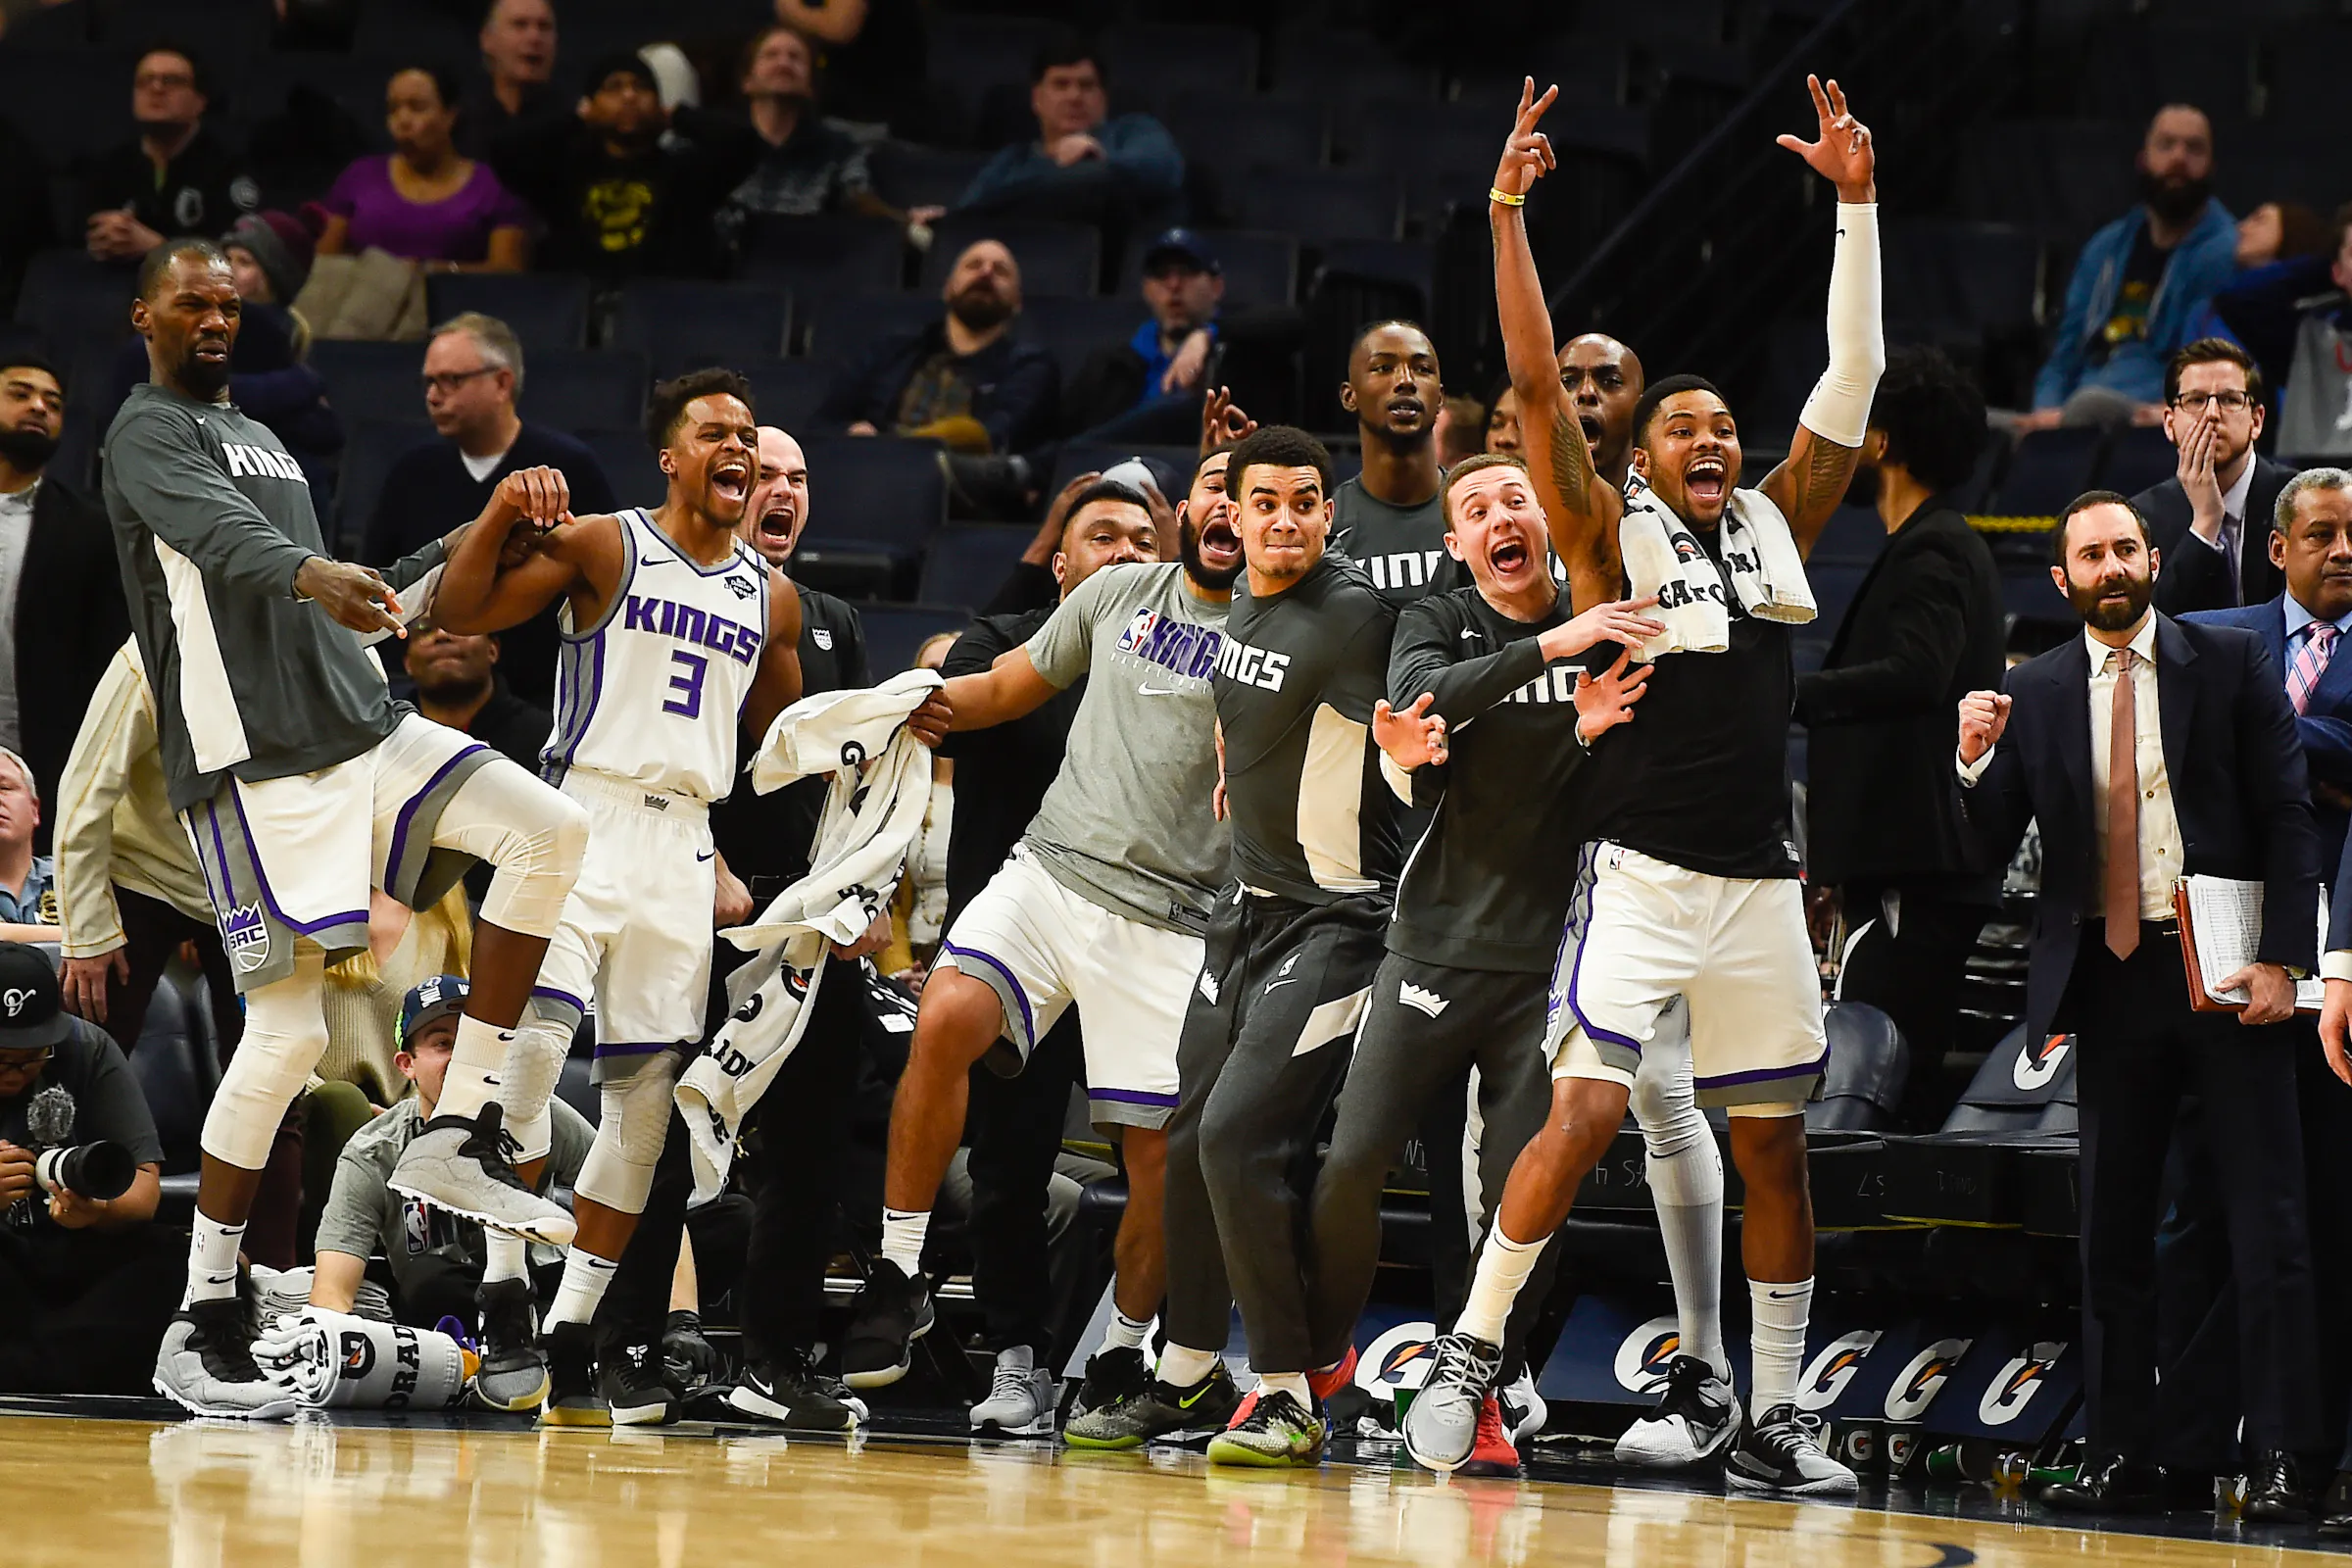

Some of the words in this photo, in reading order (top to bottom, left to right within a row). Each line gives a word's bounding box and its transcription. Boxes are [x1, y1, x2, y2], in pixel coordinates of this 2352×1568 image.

[220, 442, 309, 487] KING
[624, 595, 761, 667] KINGS
[1138, 615, 1221, 682] KING
[1215, 630, 1292, 693] INGS
[662, 649, 709, 719] 3
[1109, 651, 1208, 695] BASKETBAL
[1354, 1321, 1437, 1402] G
[1795, 1329, 1884, 1411] G
[1884, 1338, 1974, 1421] G
[1979, 1341, 2069, 1426] G
[1847, 1430, 1873, 1461] G
[1887, 1433, 1911, 1464] G
